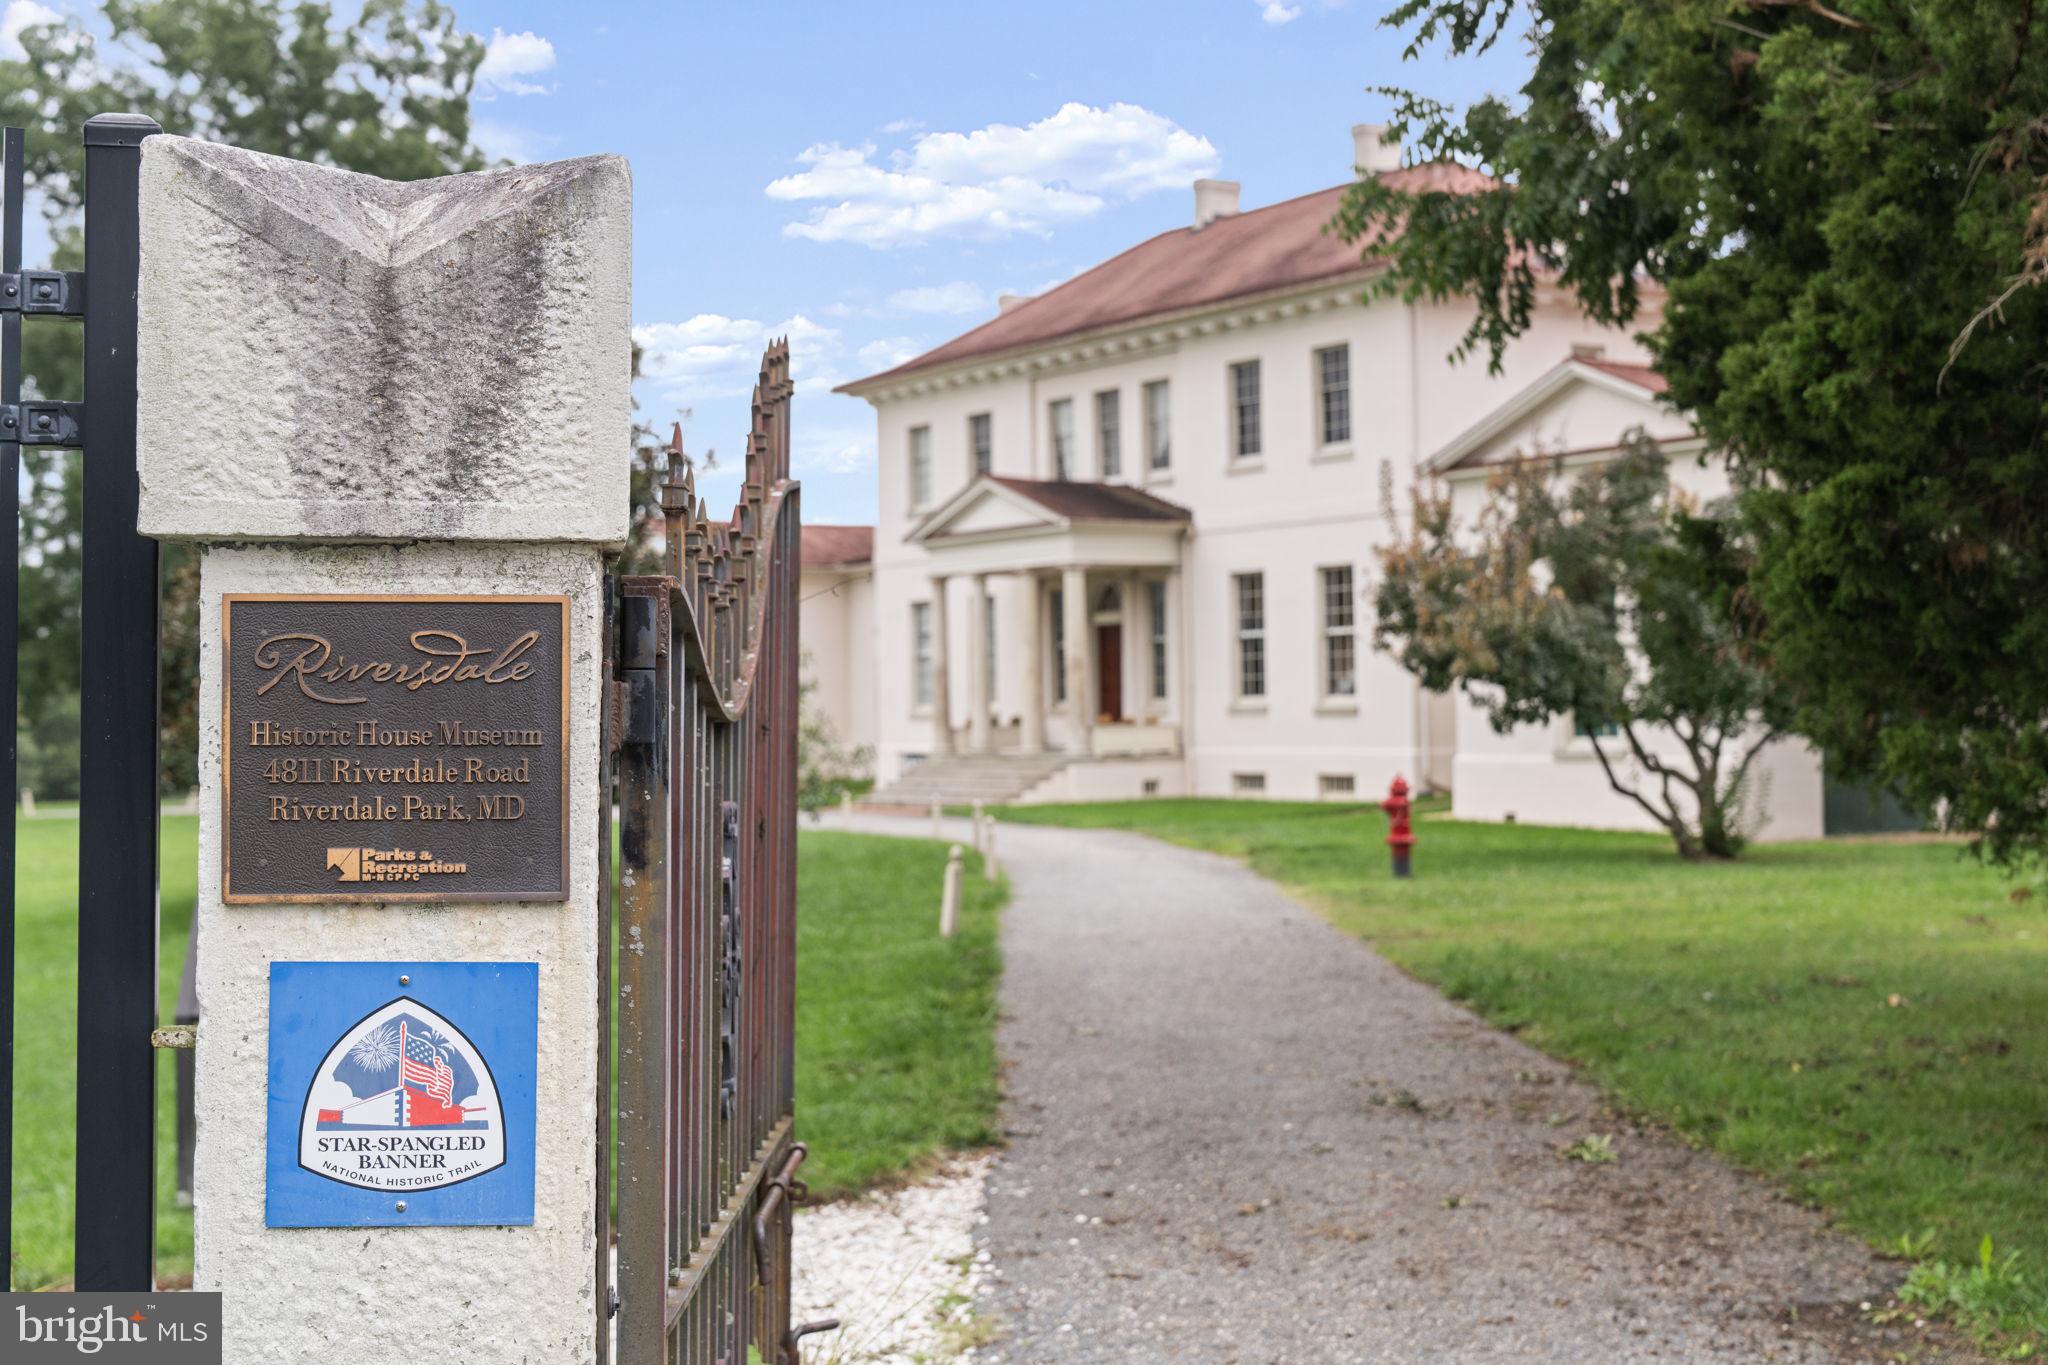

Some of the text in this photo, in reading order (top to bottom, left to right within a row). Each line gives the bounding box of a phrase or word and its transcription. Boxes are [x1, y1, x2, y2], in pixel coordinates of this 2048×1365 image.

[255, 630, 541, 704] Riversdale
[249, 721, 543, 746] Historic House Museum
[263, 758, 530, 784] 4811 Riverdale Road
[269, 796, 525, 823] Riverdale Park, MD
[362, 848, 433, 861] Parks &
[362, 861, 467, 873] Recreation
[362, 873, 421, 881] M-NCPPC
[318, 1136, 486, 1152] STAR-SPANGLED
[358, 1154, 446, 1169] BANNER
[322, 1159, 482, 1186] NATIONAL HISTORIC TRAIL
